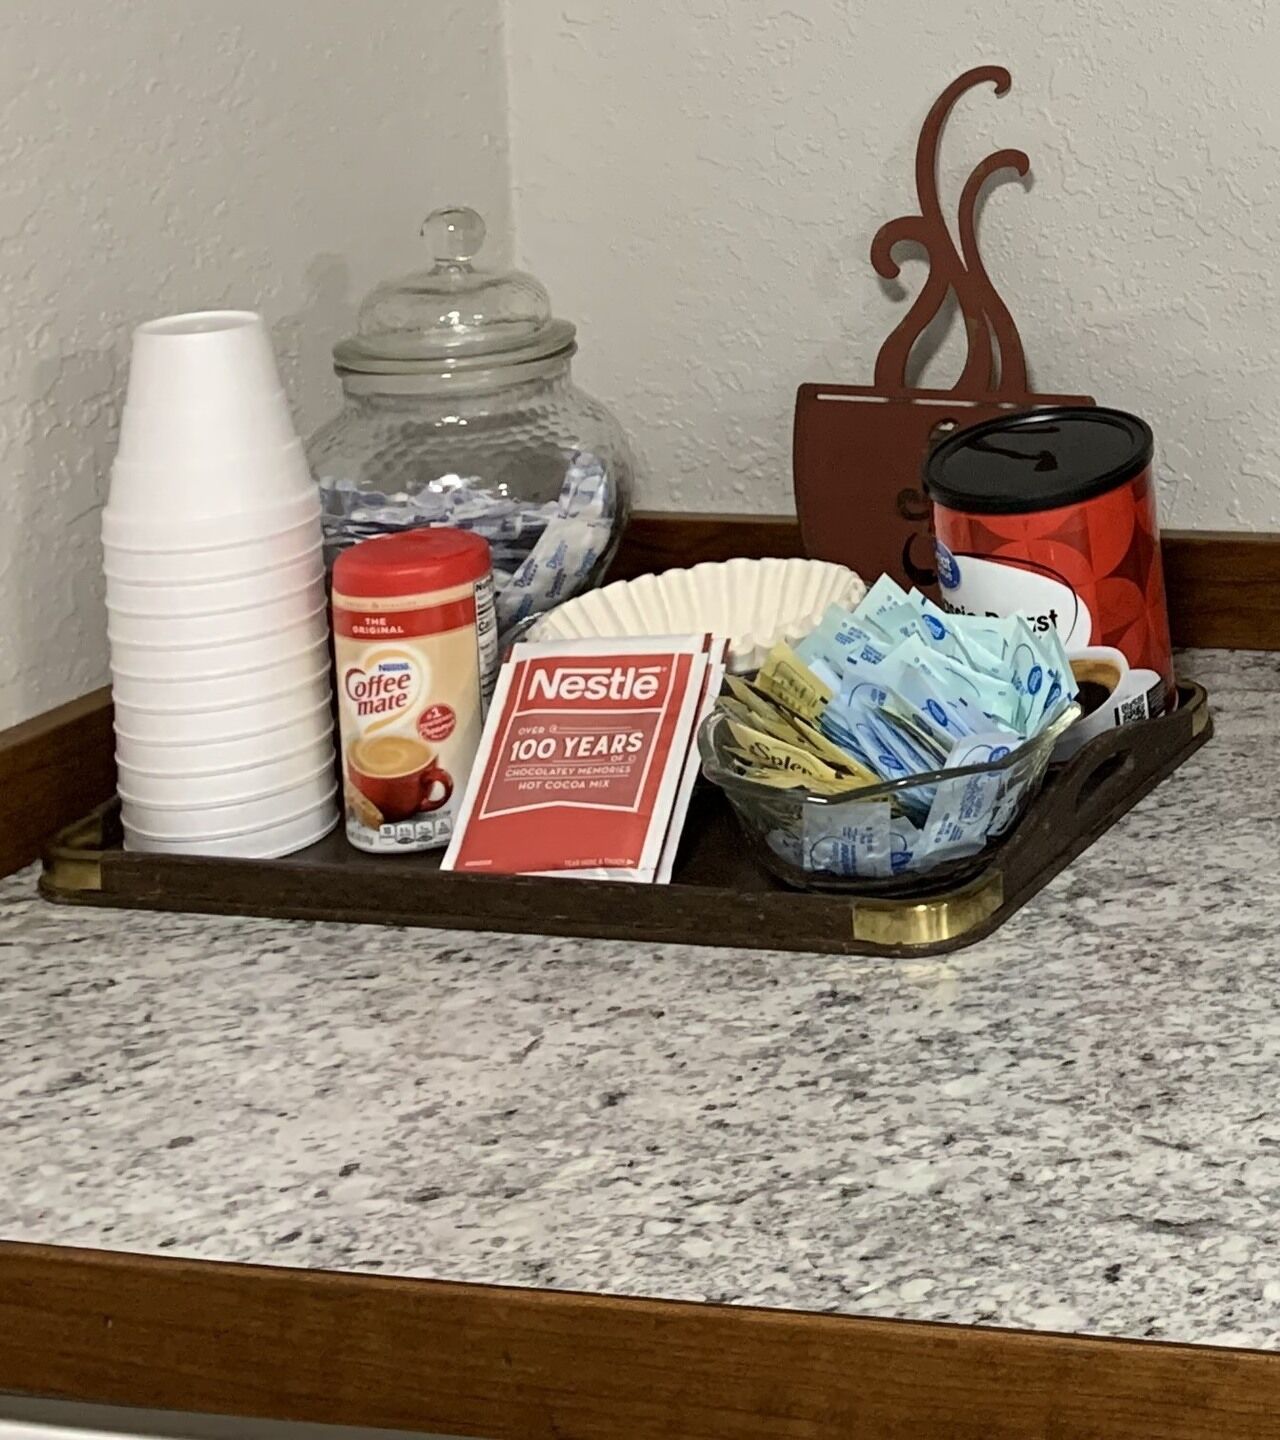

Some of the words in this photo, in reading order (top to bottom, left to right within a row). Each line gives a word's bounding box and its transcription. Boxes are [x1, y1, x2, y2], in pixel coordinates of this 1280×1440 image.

[365, 617, 387, 626] THE
[352, 625, 404, 634] ORIGINAL
[345, 668, 411, 702] Coffee
[527, 666, 662, 701] Nestlé
[357, 693, 408, 716] mate
[518, 726, 545, 736] OVER
[510, 737, 557, 762] 100
[563, 732, 645, 758] YEARS
[505, 767, 576, 777] CHOCOLATEY
[577, 765, 632, 774] MEMORIES
[518, 780, 541, 790] HOT
[544, 780, 586, 790] COCOA
[588, 779, 611, 789] MIX
